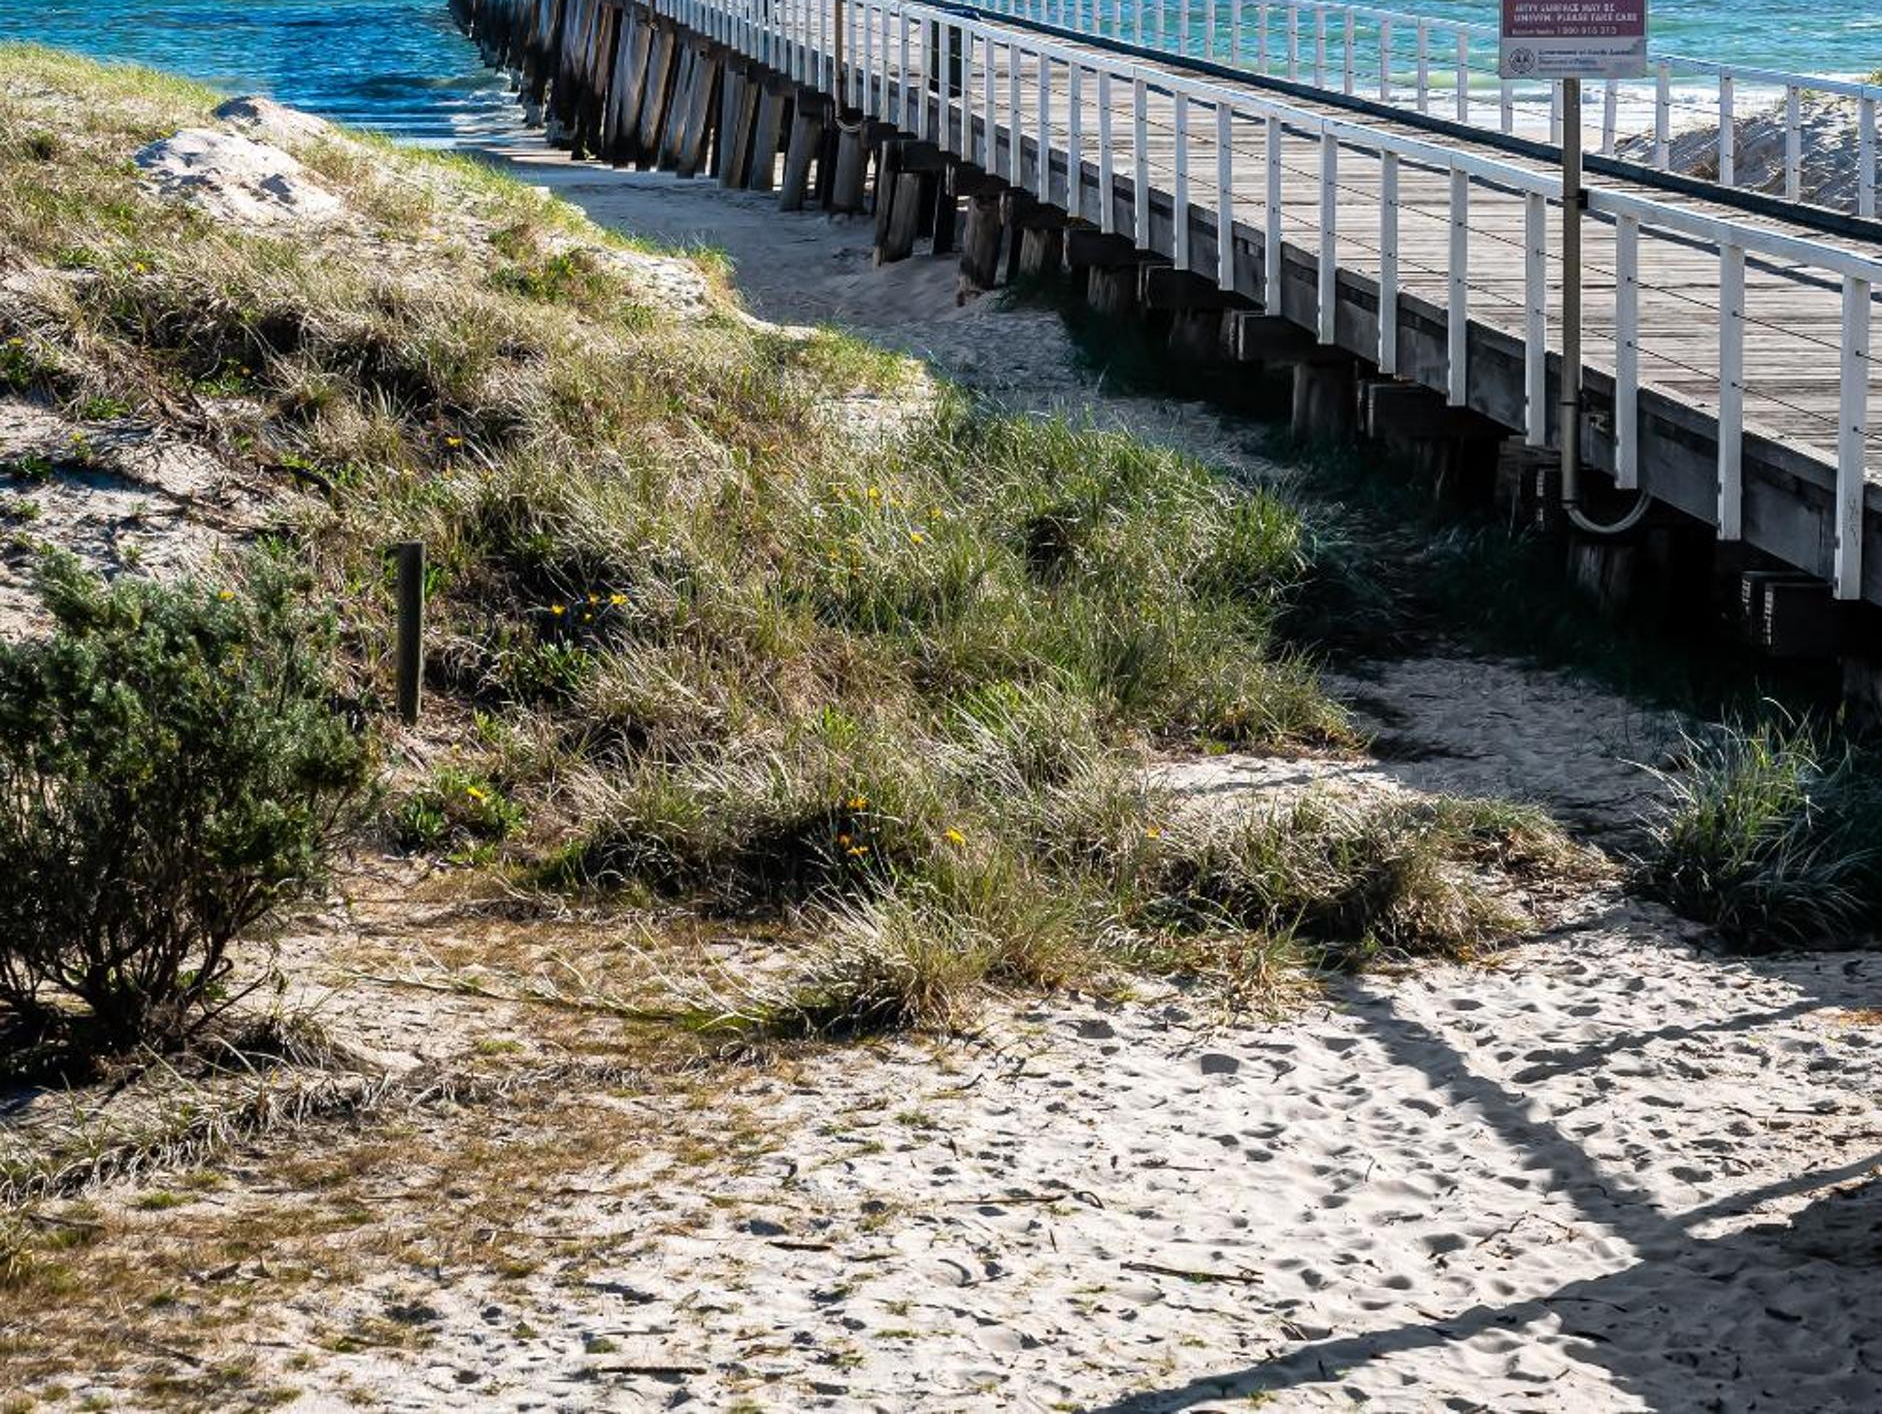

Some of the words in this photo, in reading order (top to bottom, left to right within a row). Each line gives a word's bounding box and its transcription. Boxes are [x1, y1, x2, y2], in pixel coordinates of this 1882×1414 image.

[1515, 3, 1538, 12] JETTY
[1540, 3, 1579, 12] SURFACE
[1581, 3, 1601, 12] MAY
[1604, 3, 1615, 12] BE
[1557, 13, 1588, 22] PLEASE
[1590, 13, 1613, 22] TAKE
